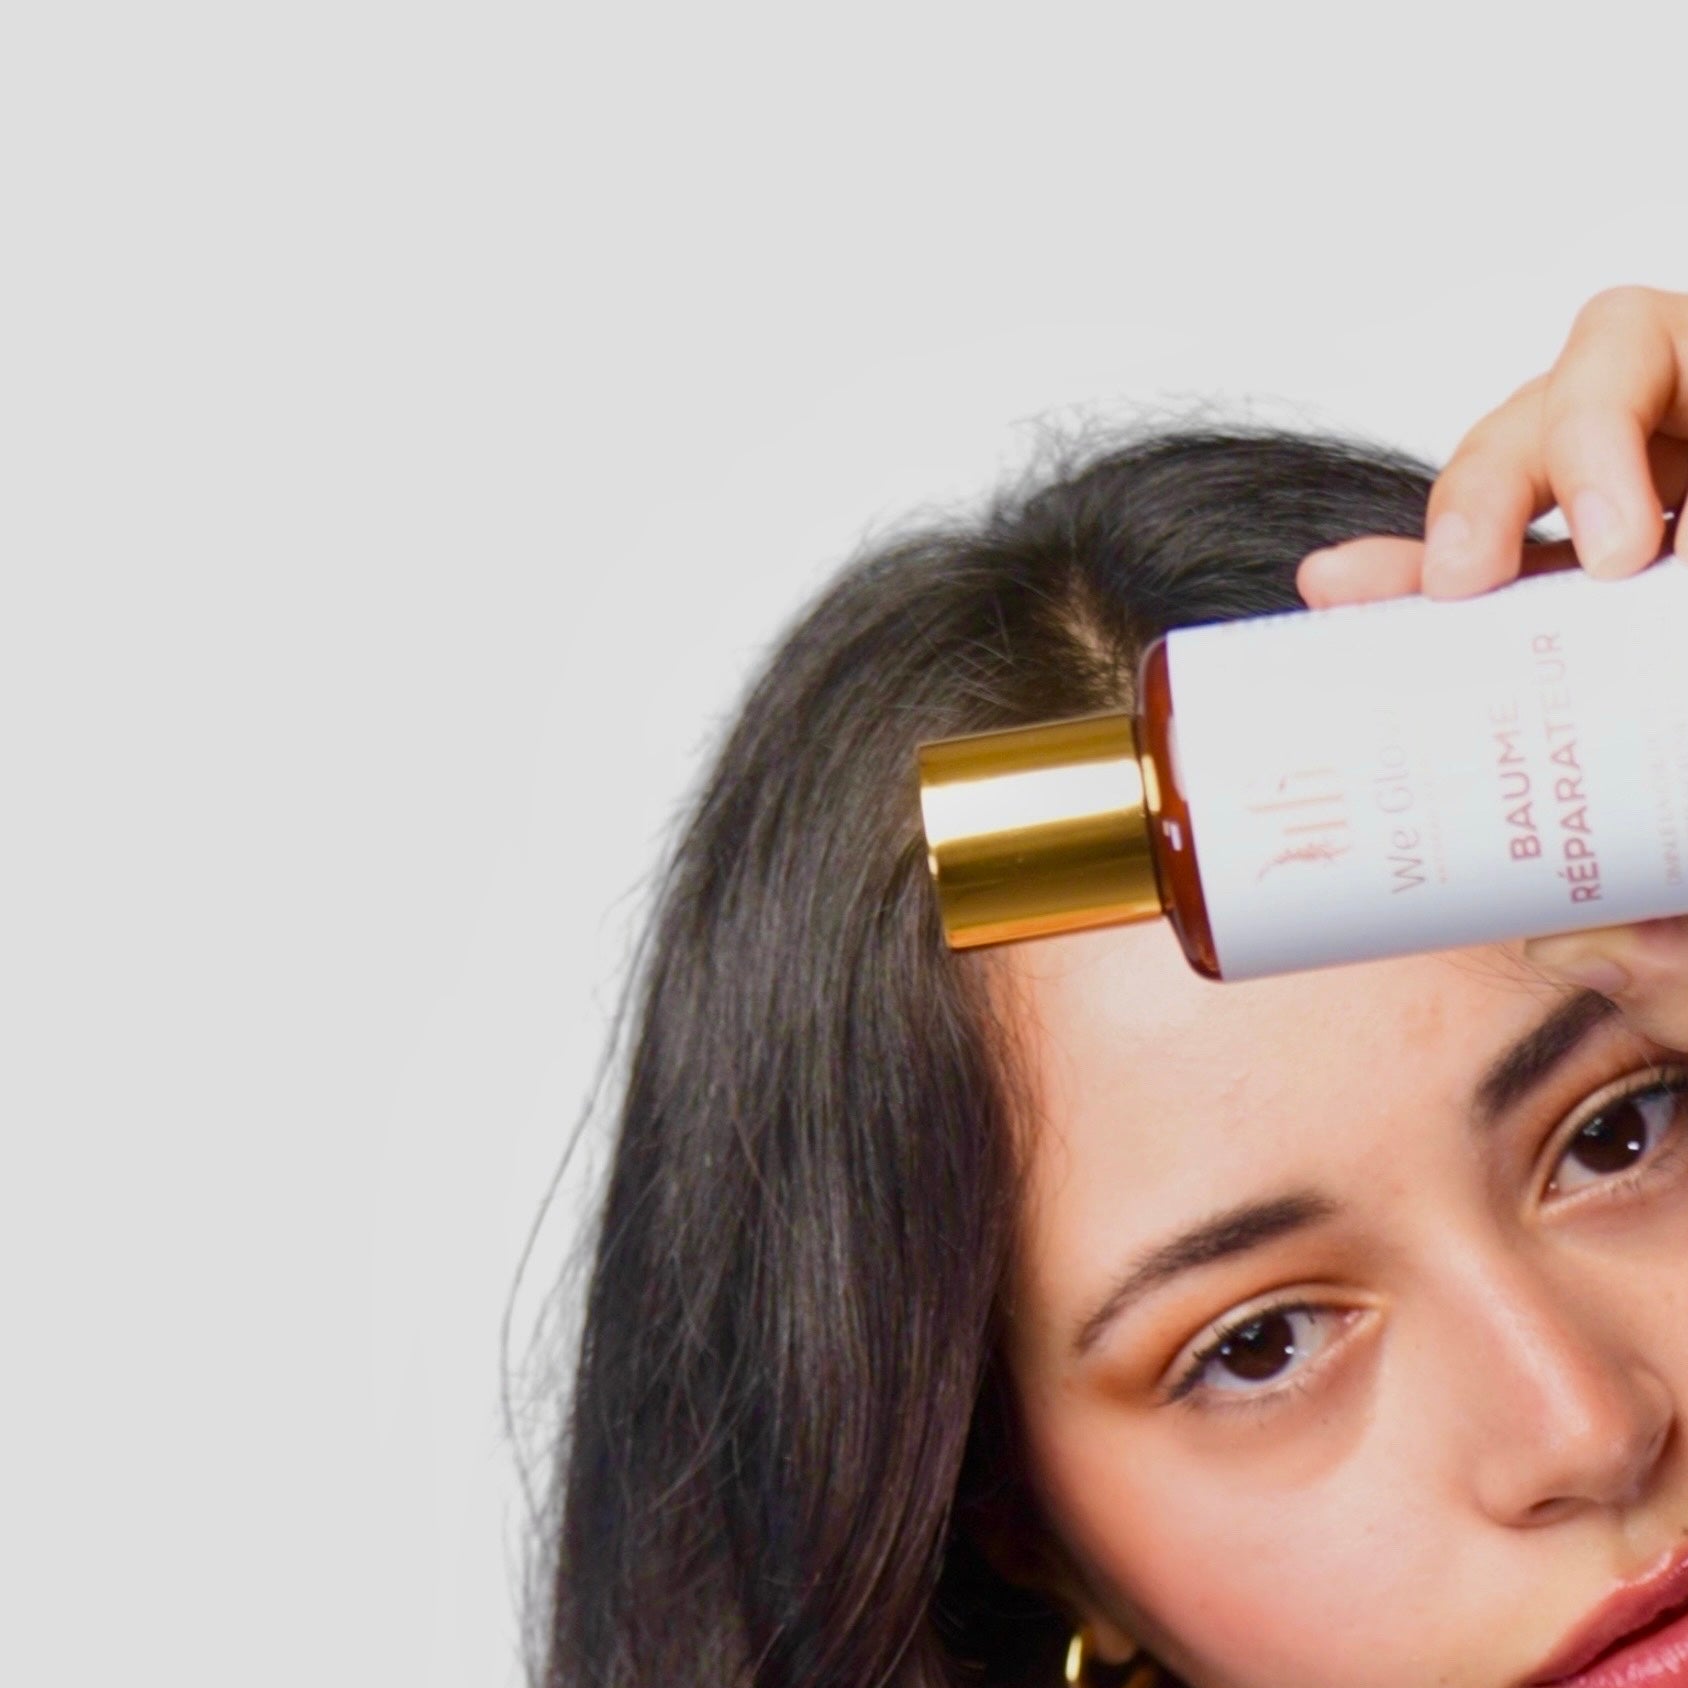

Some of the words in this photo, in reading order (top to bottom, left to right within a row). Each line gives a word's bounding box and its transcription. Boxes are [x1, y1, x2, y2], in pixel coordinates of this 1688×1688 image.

[1489, 697, 1542, 861] BAUME
[1532, 632, 1603, 904] RÉPARATEUR
[1386, 826, 1426, 894] We
